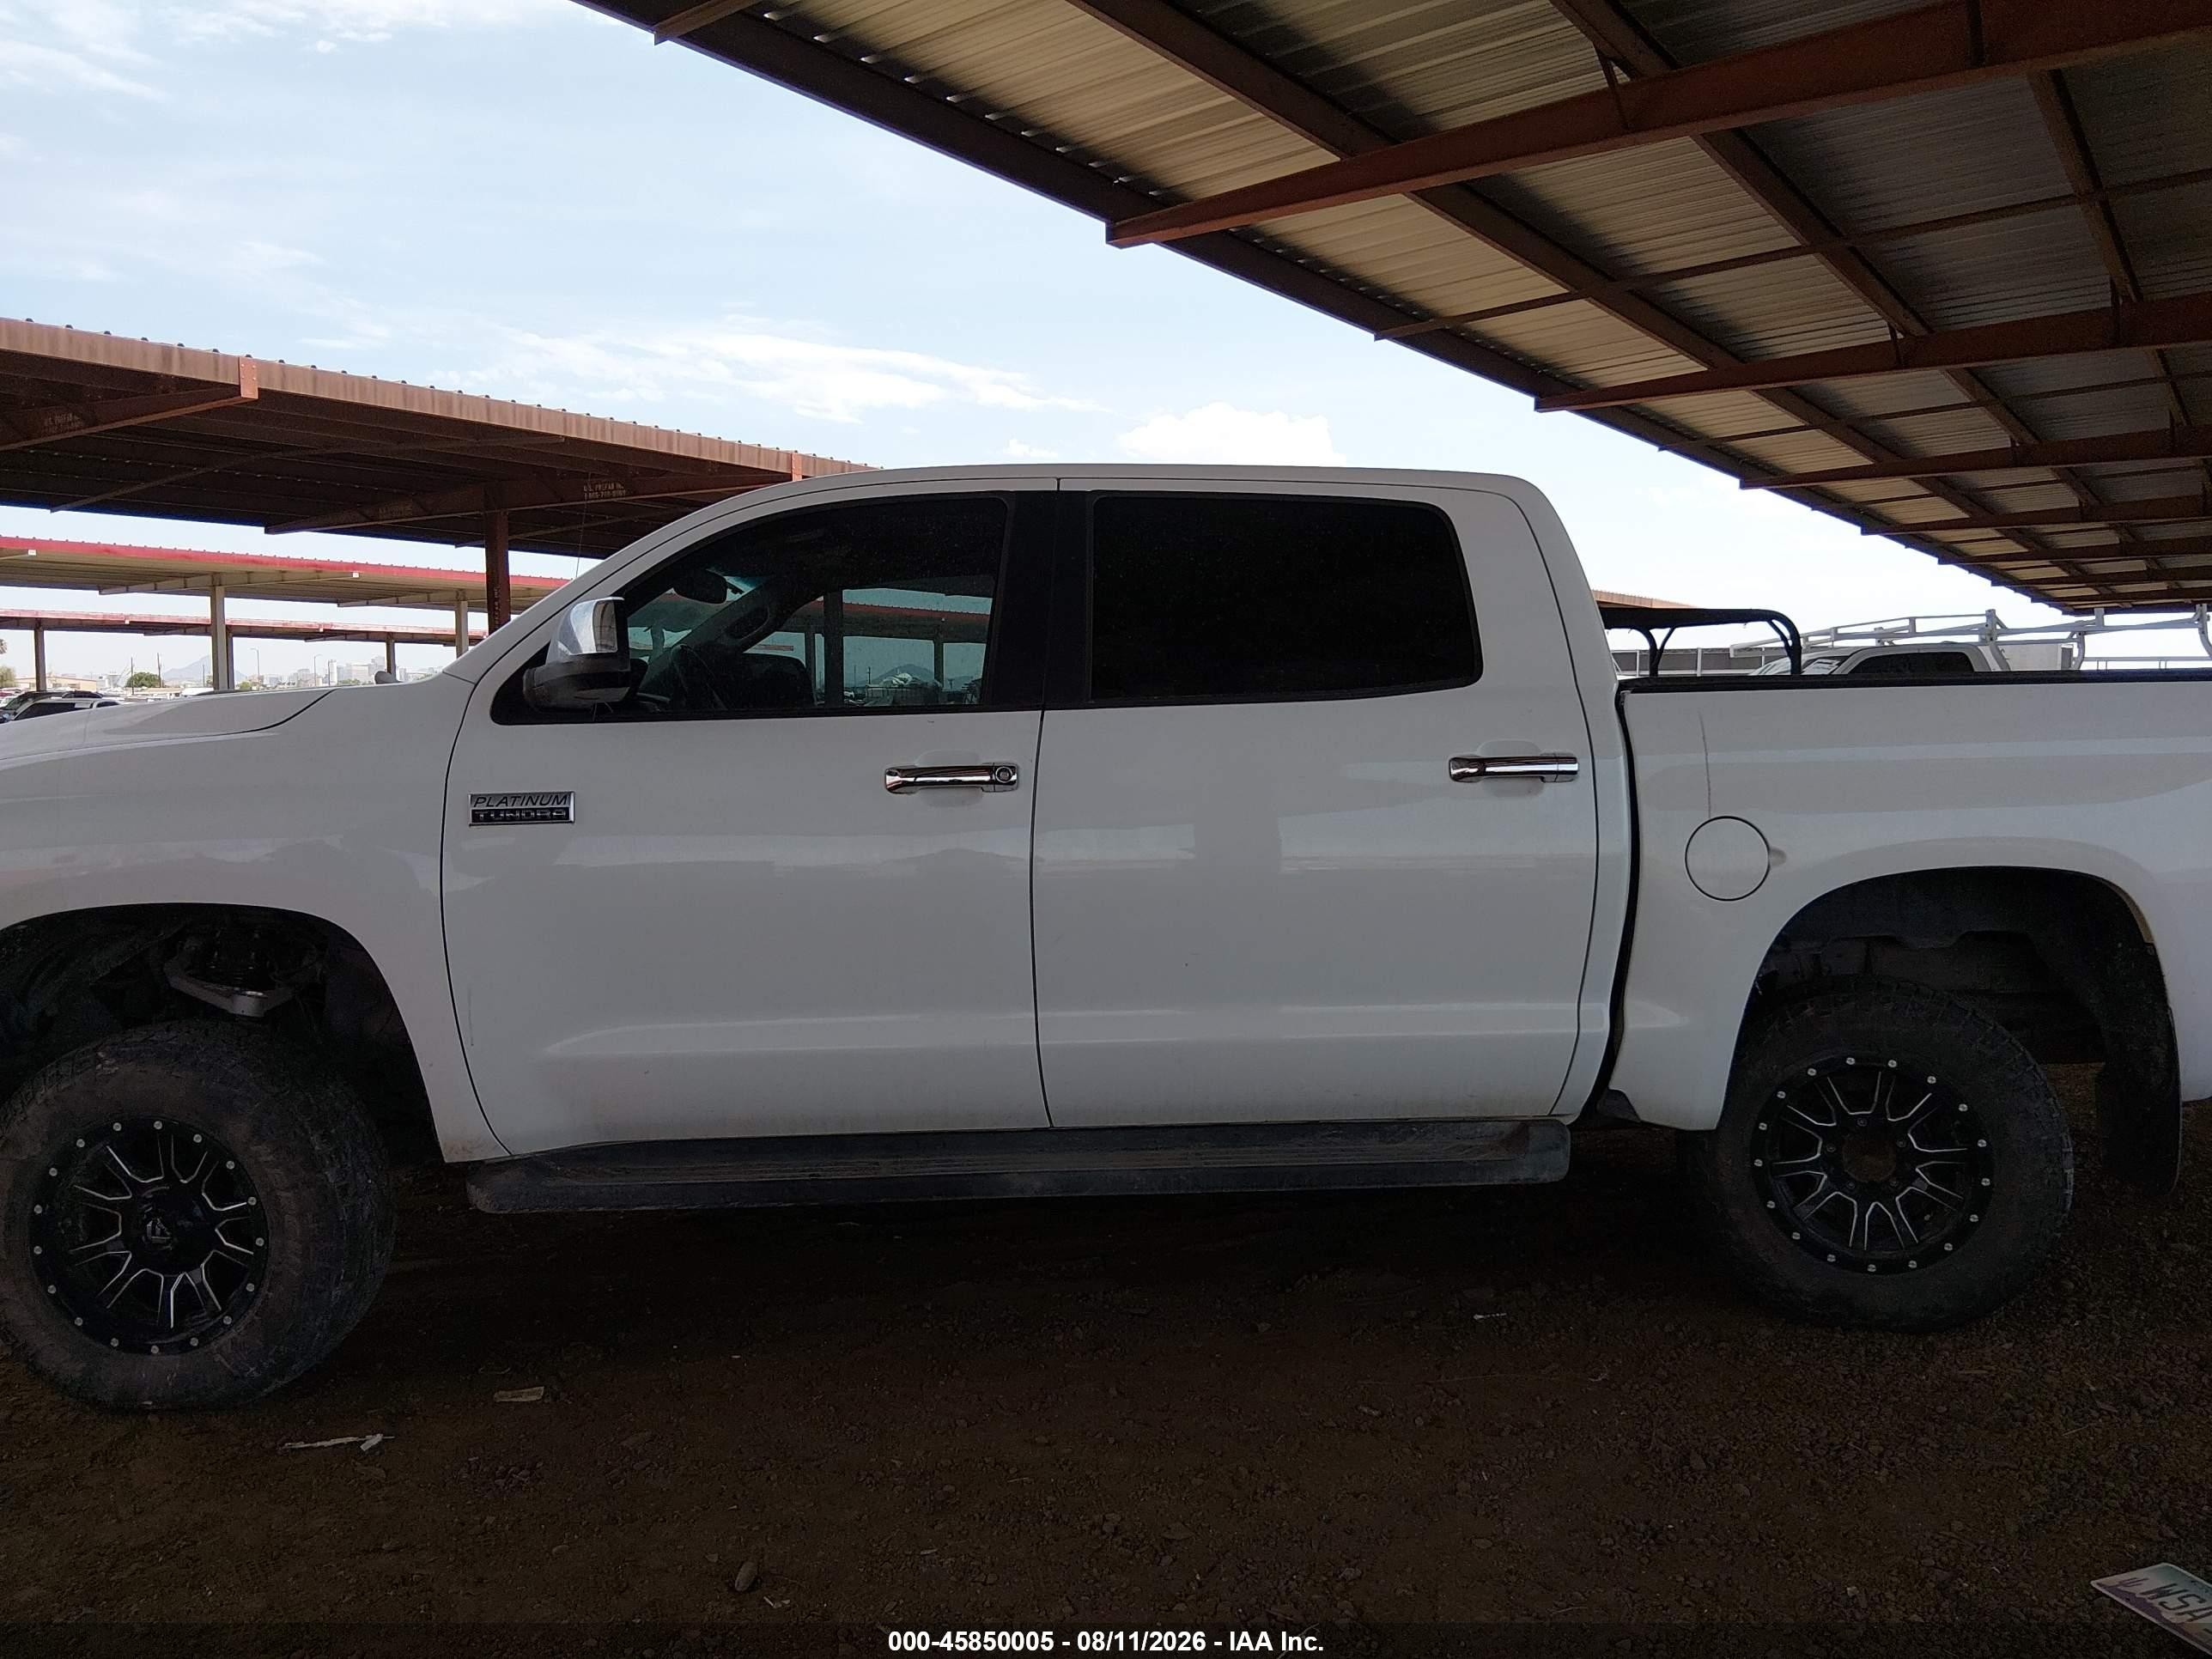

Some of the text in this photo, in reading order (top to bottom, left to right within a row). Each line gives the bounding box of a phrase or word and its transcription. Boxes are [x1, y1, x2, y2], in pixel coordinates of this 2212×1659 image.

[473, 794, 568, 808] PLATINUM
[474, 809, 567, 821] TUNDRA
[2137, 1583, 2212, 1632] WSA
